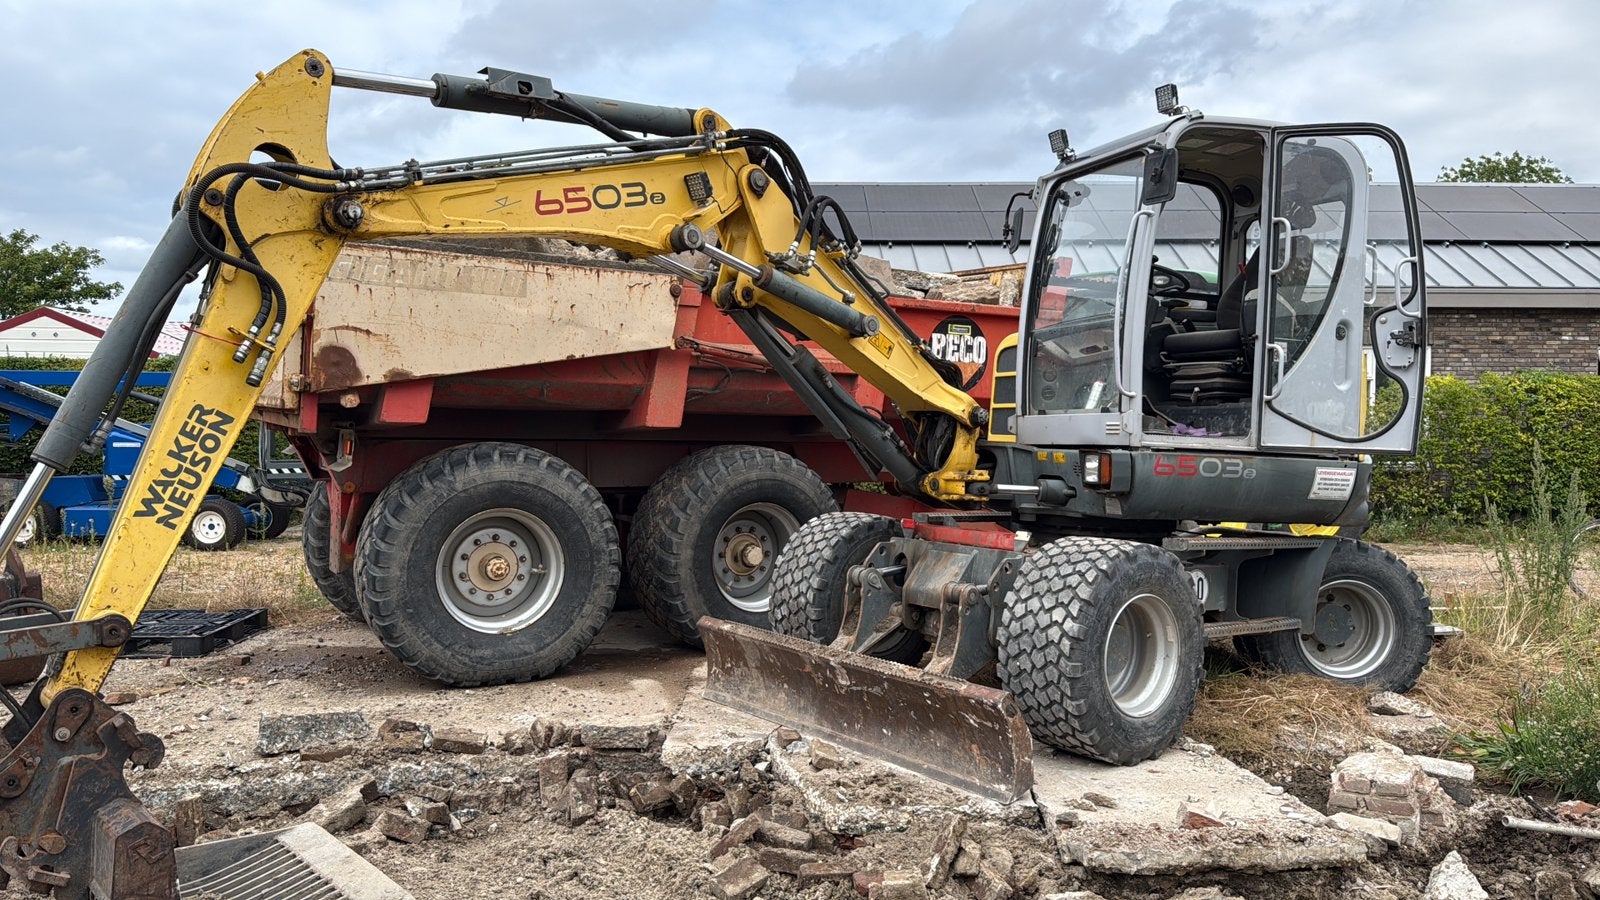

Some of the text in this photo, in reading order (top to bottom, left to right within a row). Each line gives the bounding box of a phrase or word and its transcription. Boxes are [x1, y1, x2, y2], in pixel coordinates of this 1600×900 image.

[534, 181, 648, 216] 6503
[133, 404, 215, 517] WACKER
[156, 410, 235, 530] NEUSON
[1152, 454, 1244, 478] 6503
